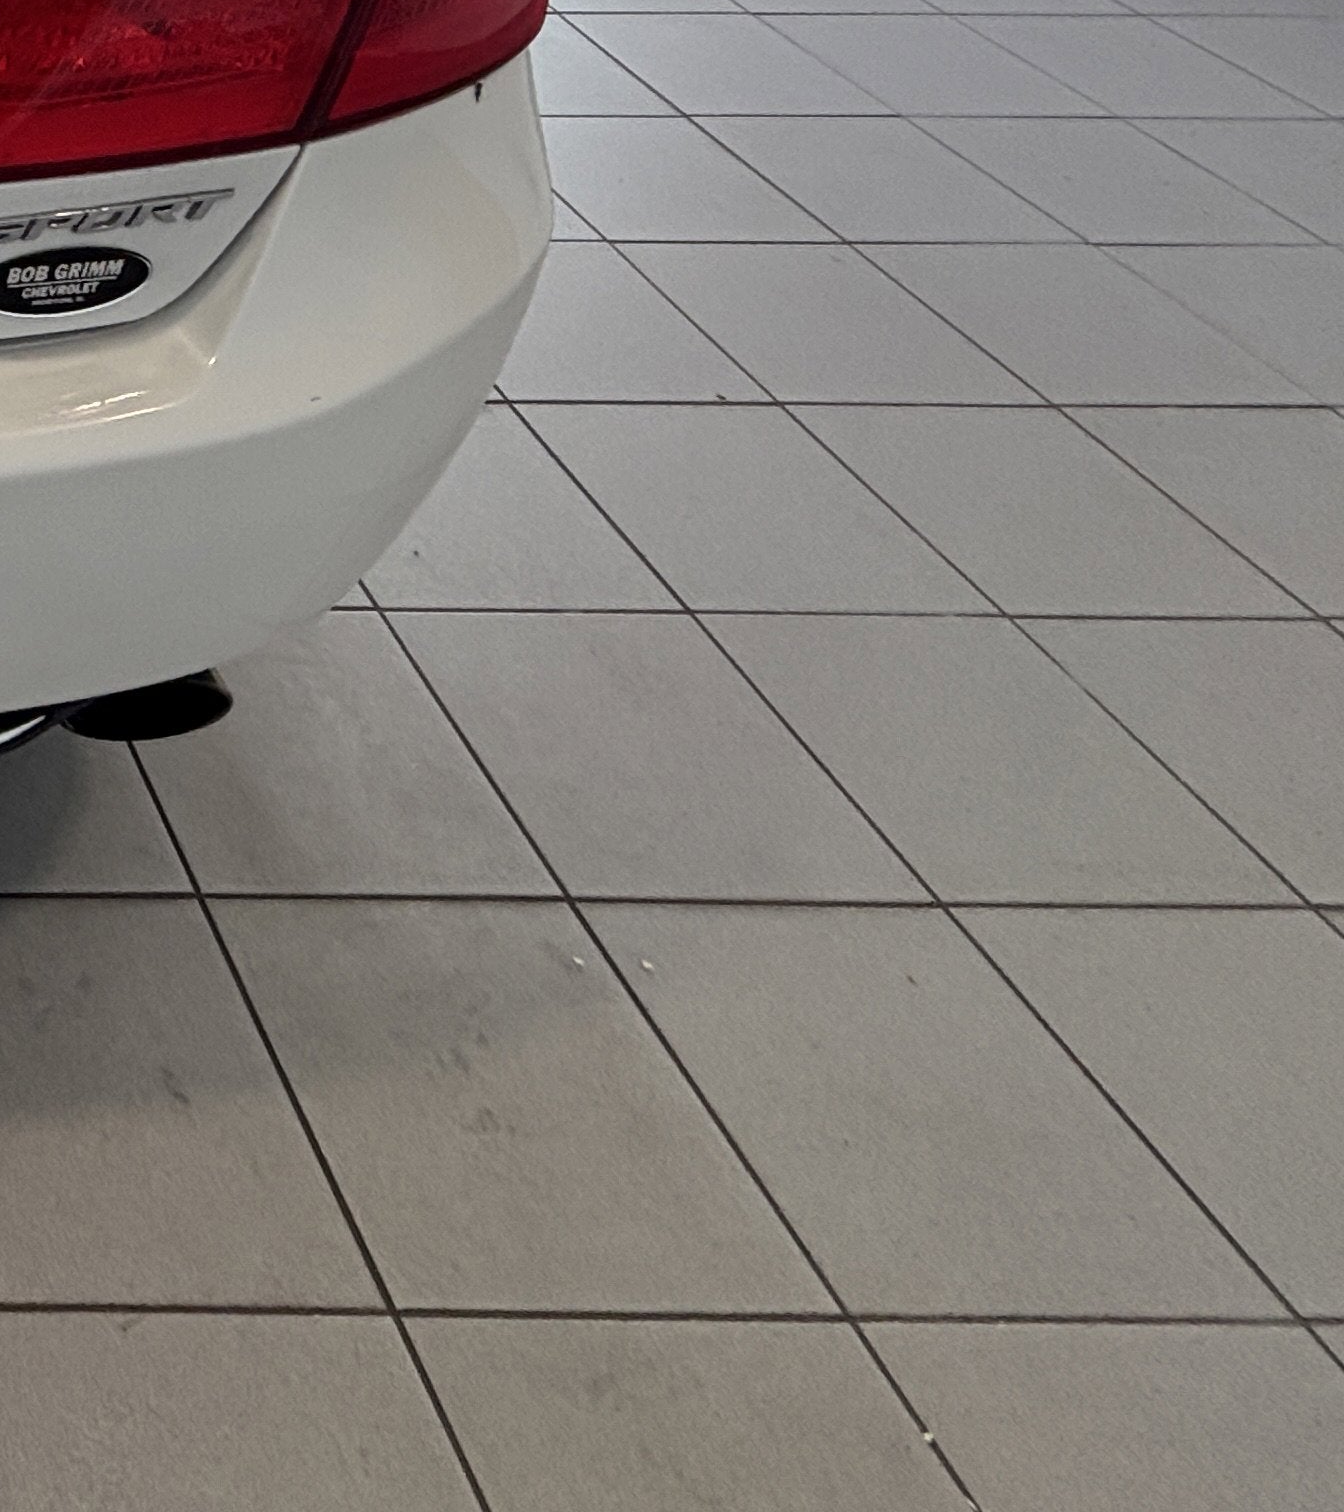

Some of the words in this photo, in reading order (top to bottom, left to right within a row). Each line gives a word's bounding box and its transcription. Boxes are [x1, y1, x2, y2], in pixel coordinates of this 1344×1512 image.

[7, 266, 49, 284] BOB
[54, 259, 125, 280] GRIMM
[21, 282, 100, 299] CHEVROLET
